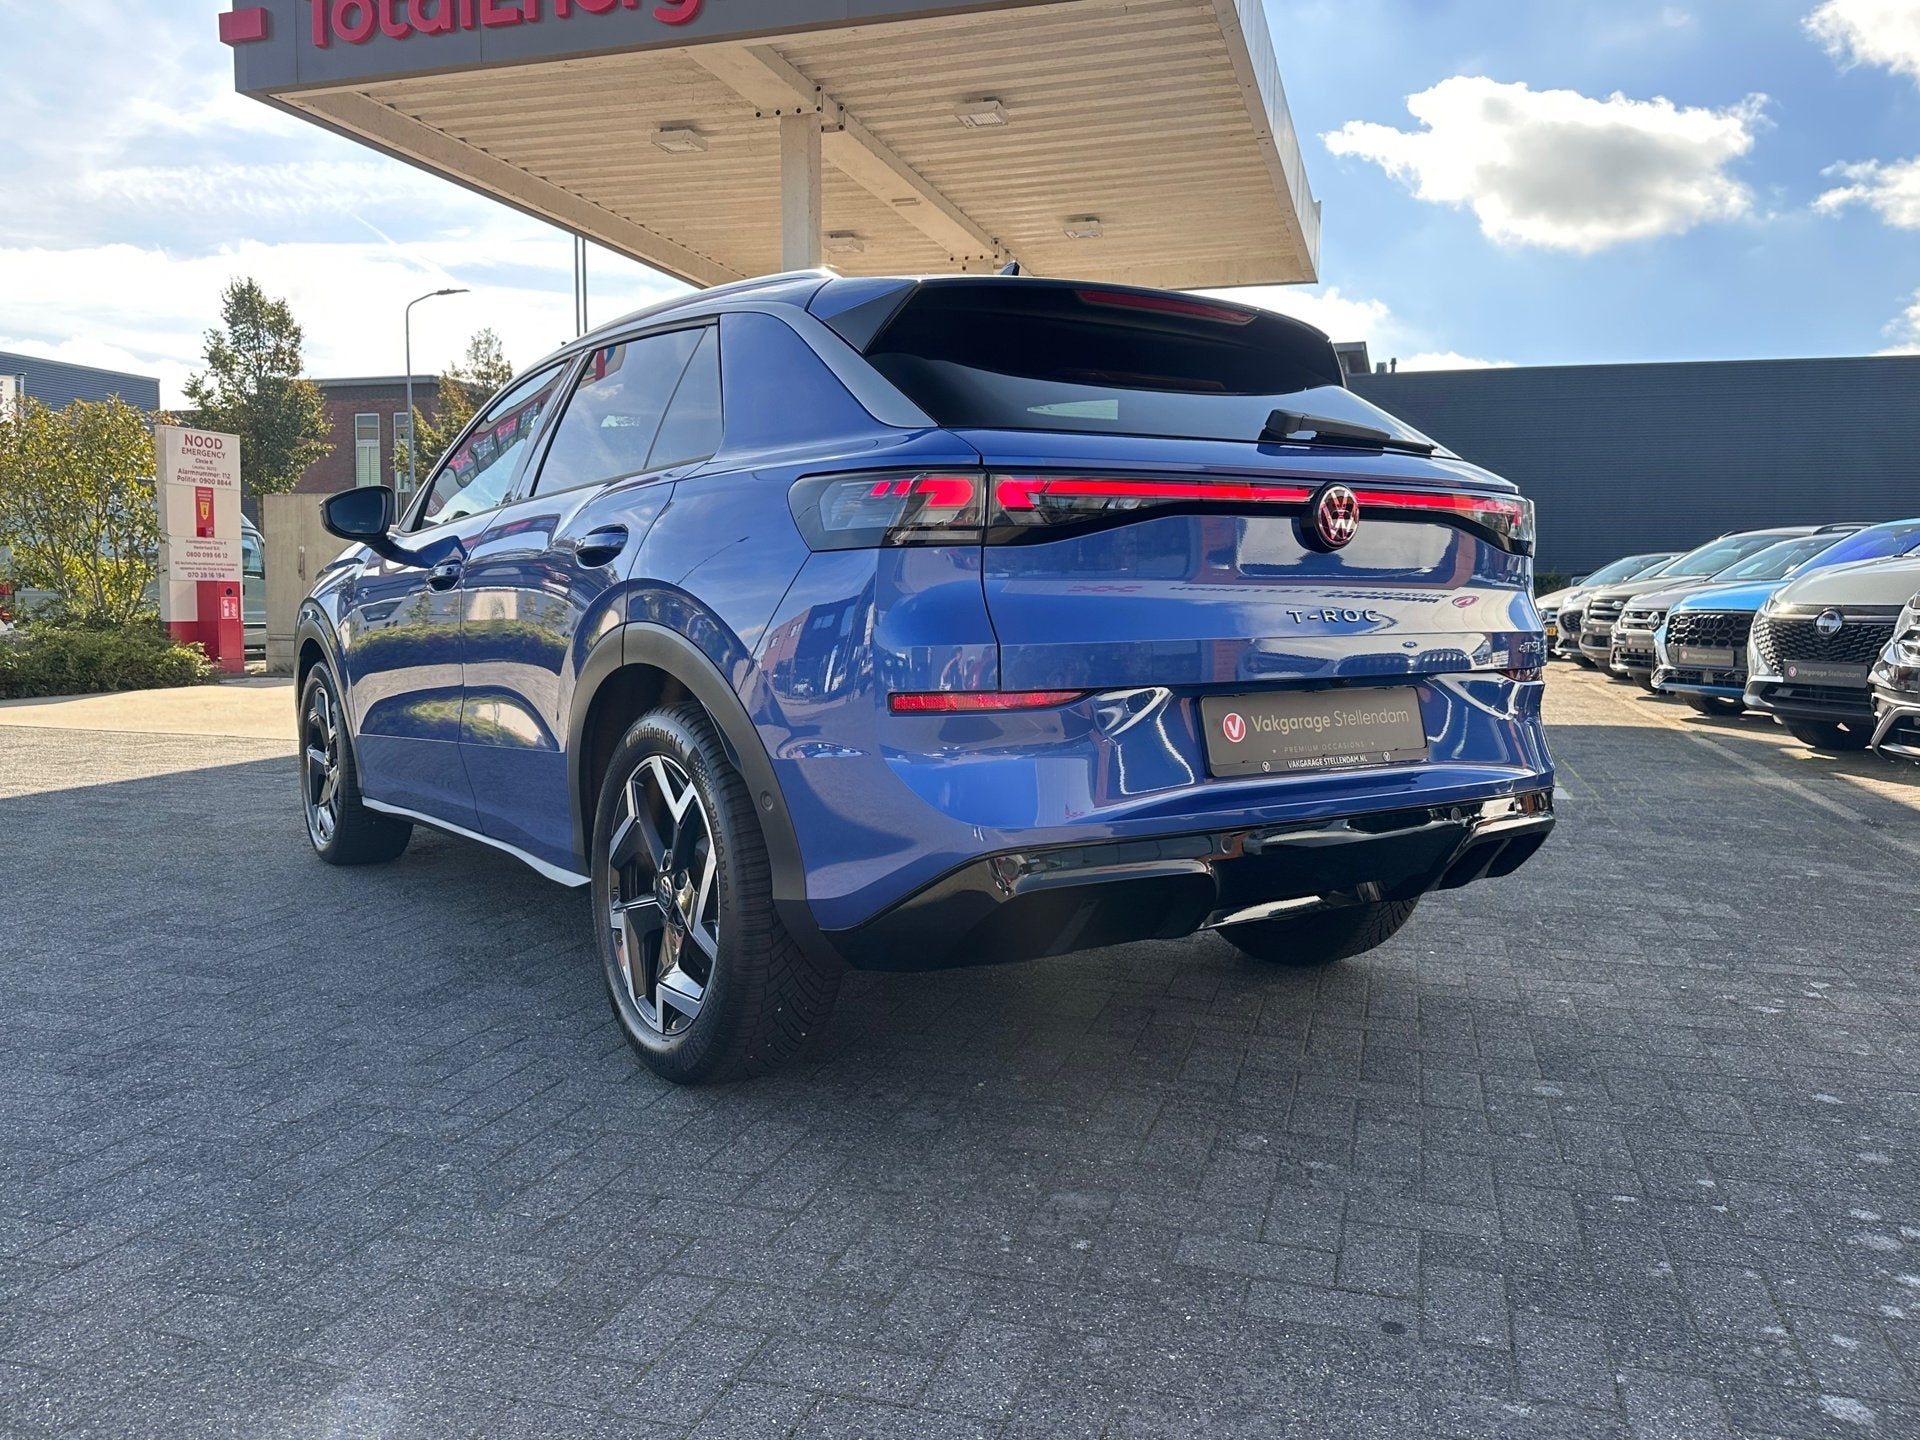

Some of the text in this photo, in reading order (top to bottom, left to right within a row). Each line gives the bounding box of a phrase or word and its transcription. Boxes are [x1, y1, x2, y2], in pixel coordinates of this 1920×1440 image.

[185, 433, 223, 450] NOOD
[181, 447, 226, 459] EMERGENCY
[176, 475, 198, 483] Politie:
[199, 477, 216, 485] 0900
[177, 468, 221, 478] Alarmnummer:
[1286, 608, 1380, 624] T-ROC
[1250, 714, 1331, 735] Vakgarage
[1333, 708, 1409, 727] Stellendam
[629, 726, 679, 751] Continental
[1284, 741, 1365, 753] PREMIUM OCCASIONS
[707, 802, 724, 856] 225/50
